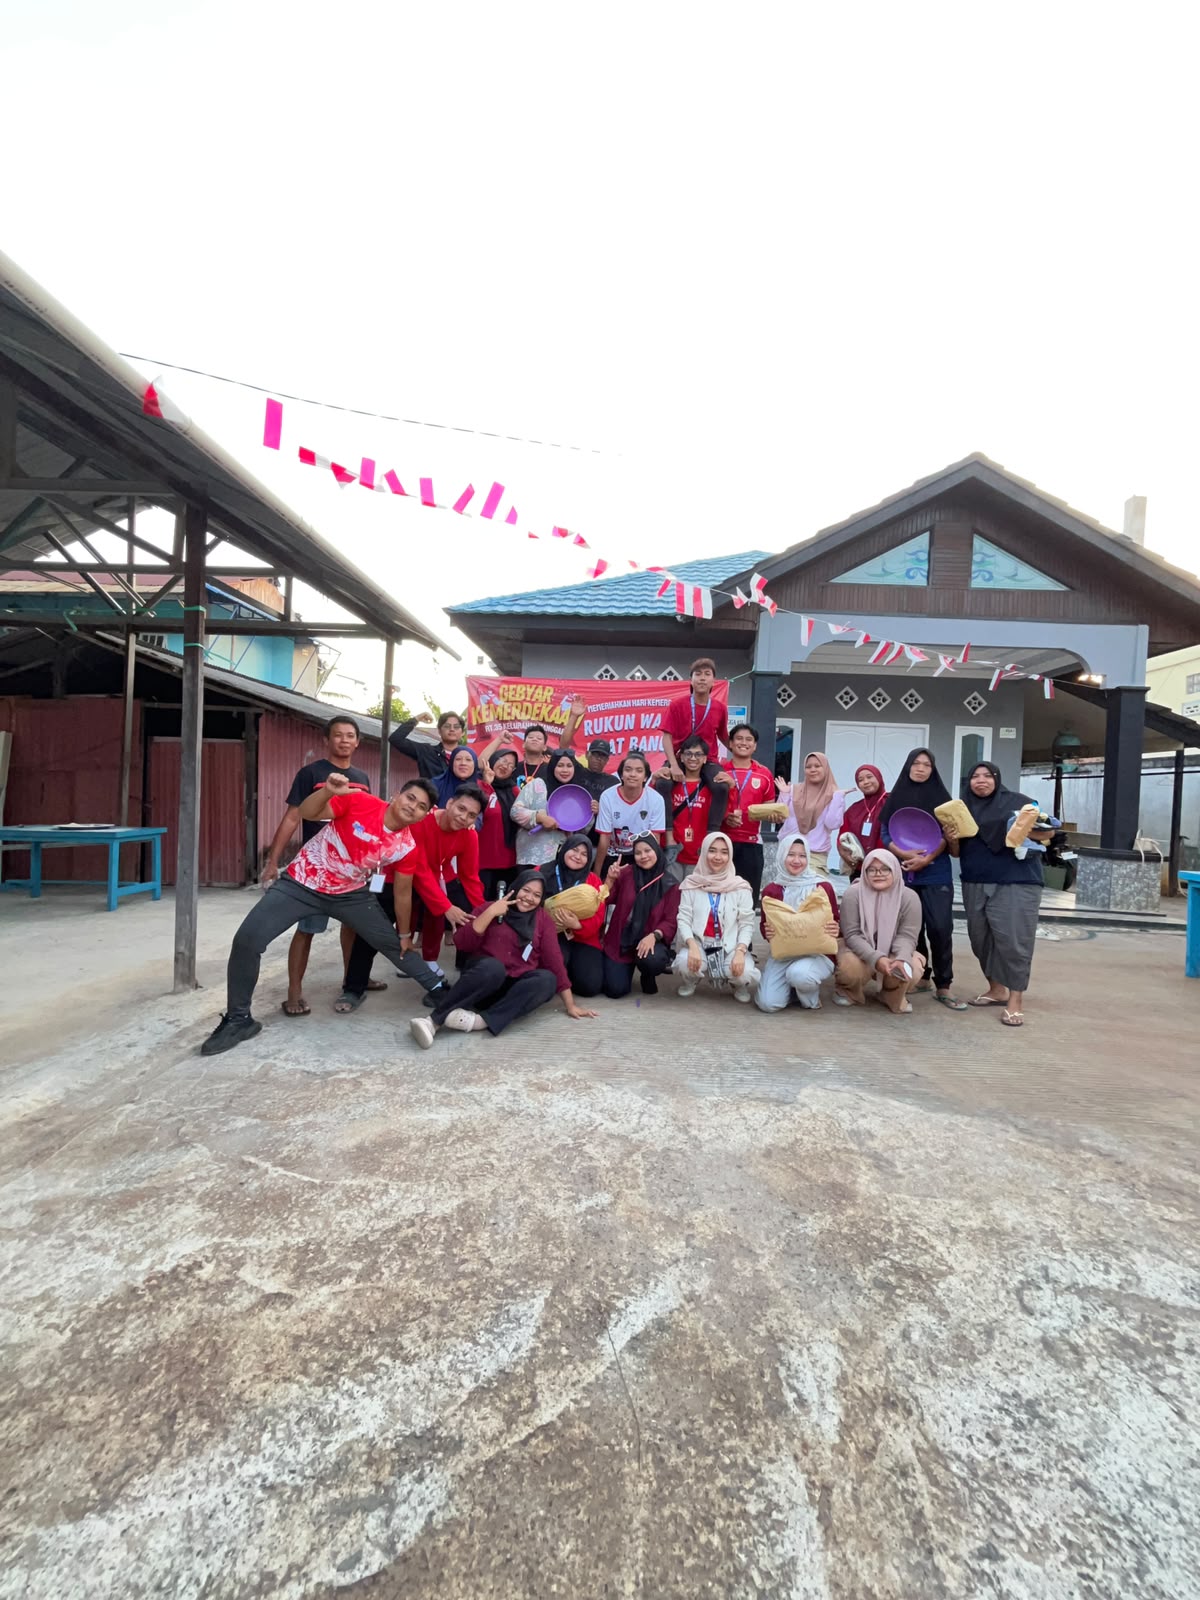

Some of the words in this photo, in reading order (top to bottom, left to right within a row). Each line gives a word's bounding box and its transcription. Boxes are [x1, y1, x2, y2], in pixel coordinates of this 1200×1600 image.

[499, 684, 554, 703] GEBYAR
[587, 699, 632, 713] MEMERIAHKAN
[632, 698, 646, 707] HARI
[583, 713, 636, 736] RUKUN
